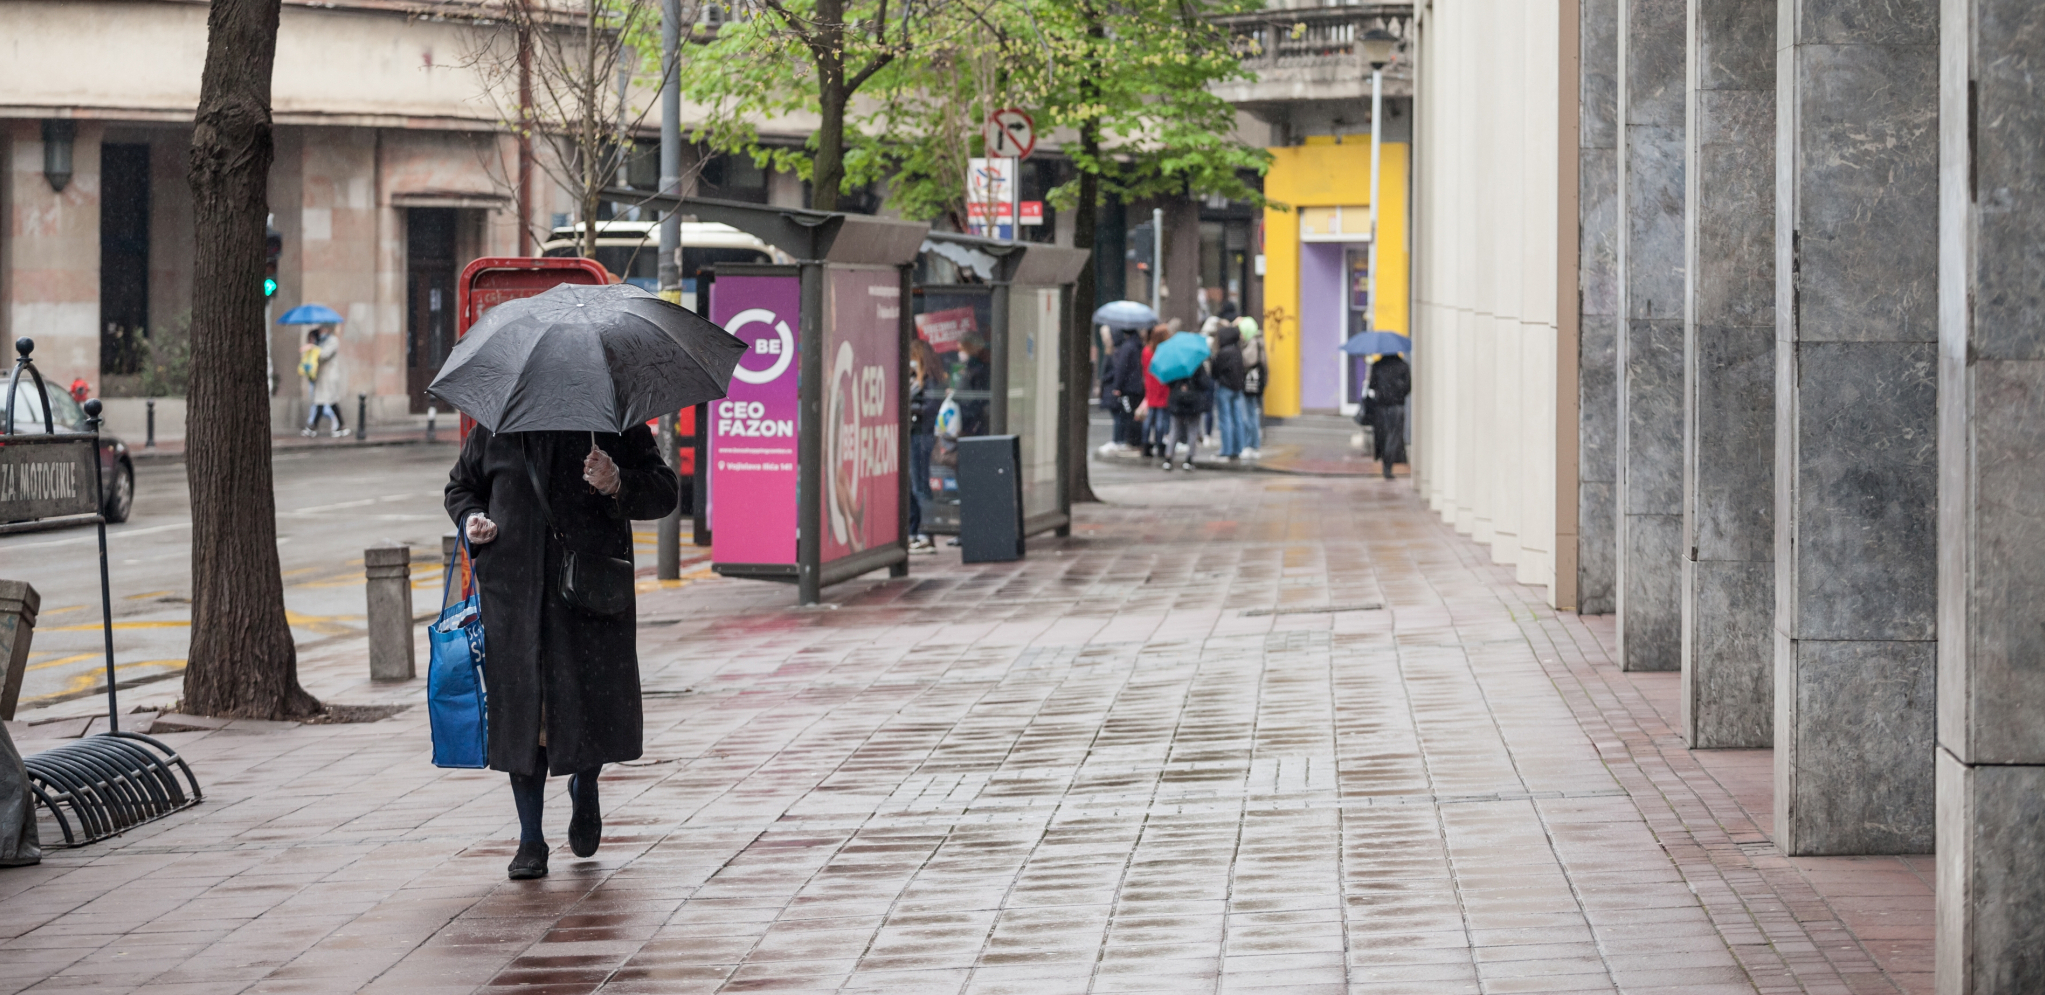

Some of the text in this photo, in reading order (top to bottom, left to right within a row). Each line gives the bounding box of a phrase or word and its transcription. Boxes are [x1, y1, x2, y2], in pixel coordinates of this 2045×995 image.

[718, 401, 765, 419] CEO
[861, 365, 885, 418] CEO
[718, 419, 793, 437] FAZON
[860, 423, 898, 478] FAZON
[1, 462, 76, 501] ZA MOTOCIKLE
